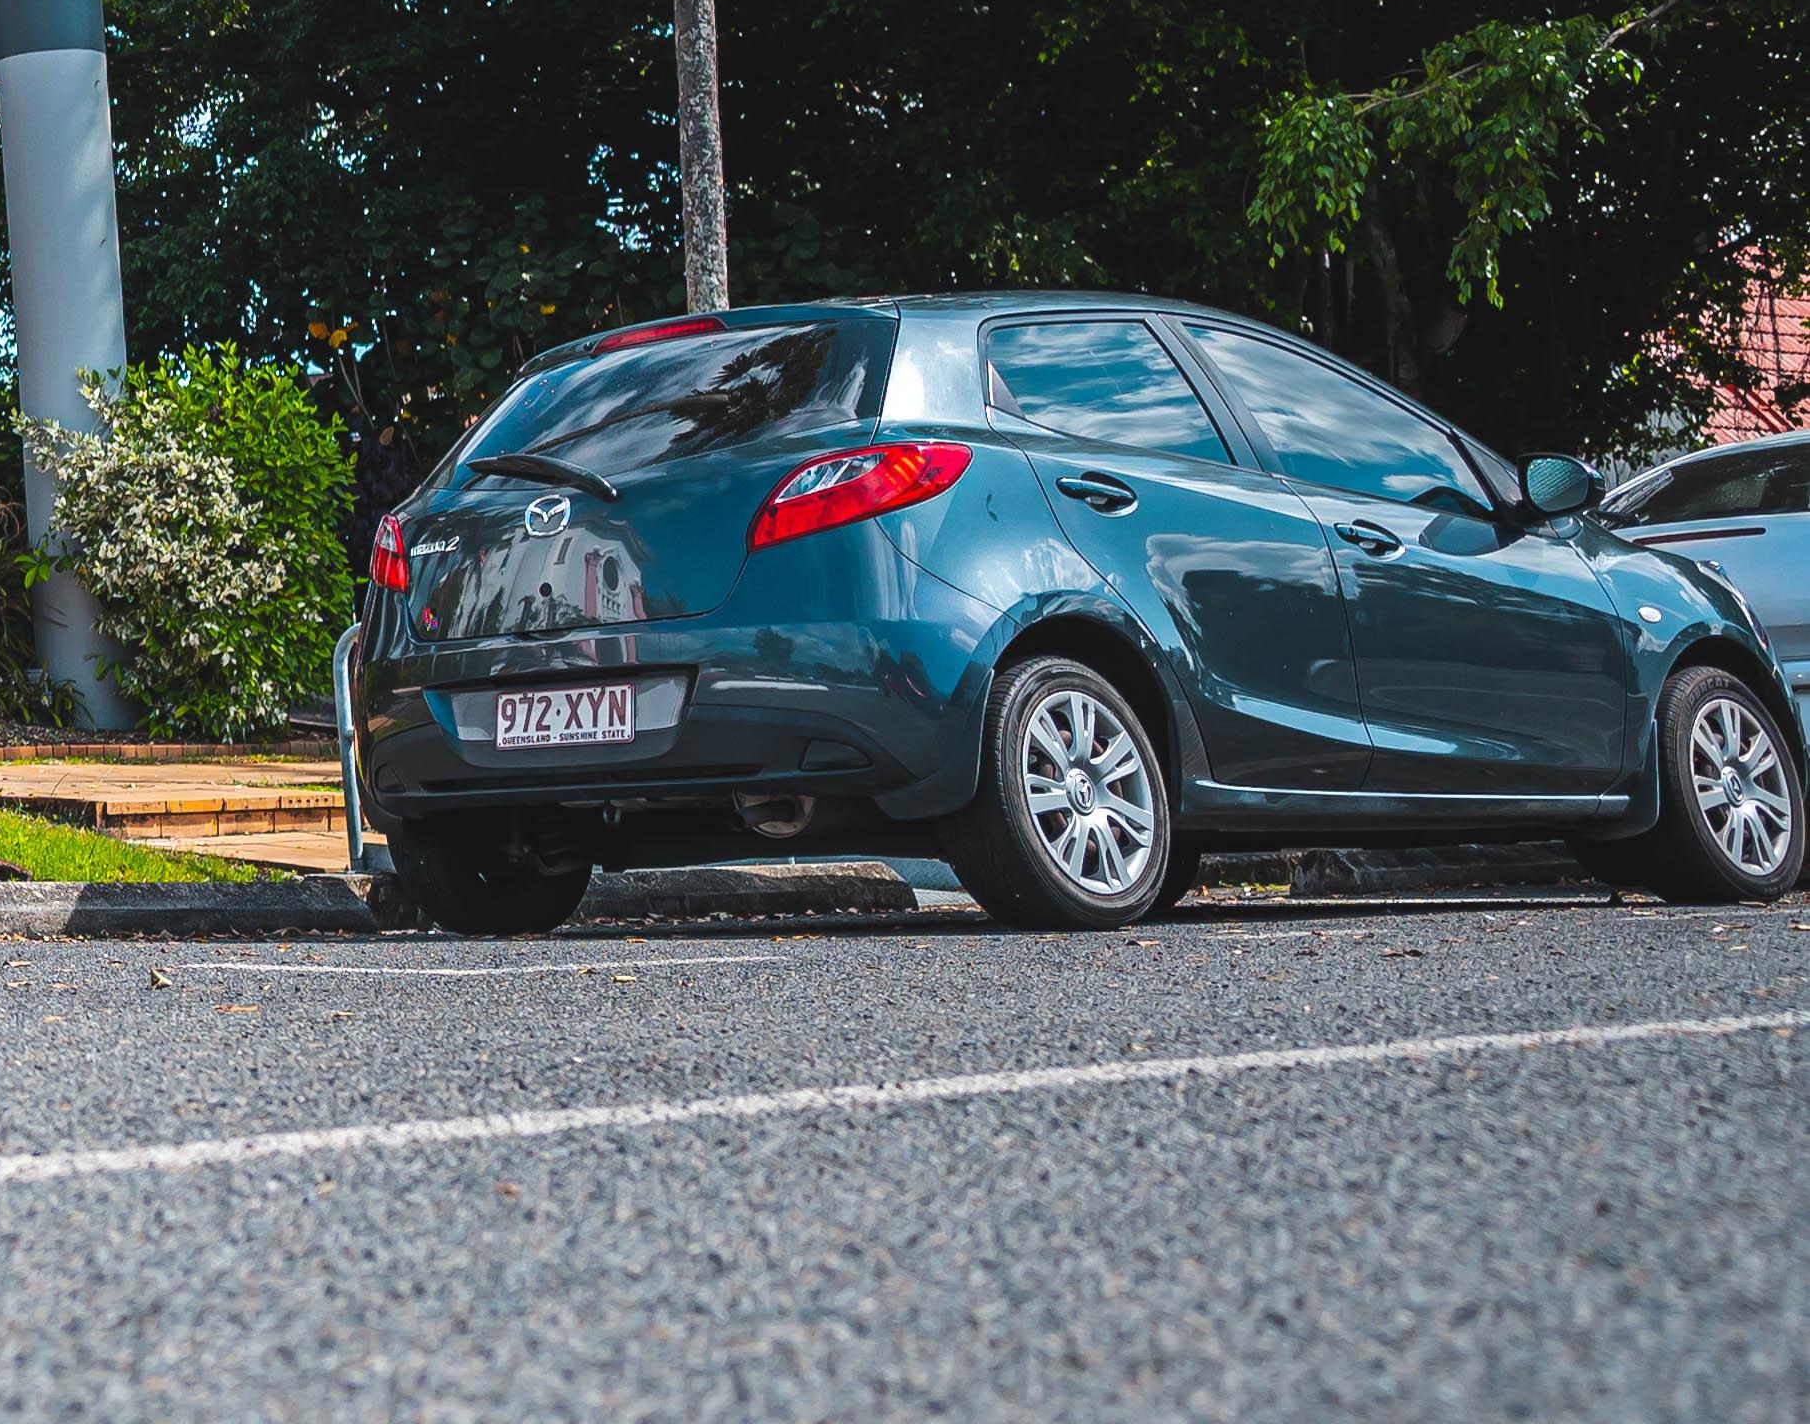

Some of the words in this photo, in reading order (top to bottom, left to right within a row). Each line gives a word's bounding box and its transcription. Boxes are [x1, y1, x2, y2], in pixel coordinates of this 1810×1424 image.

[502, 735, 551, 745] QUEENSLAND
[559, 731, 598, 741] SUNSHINE
[601, 729, 626, 739] STATE
